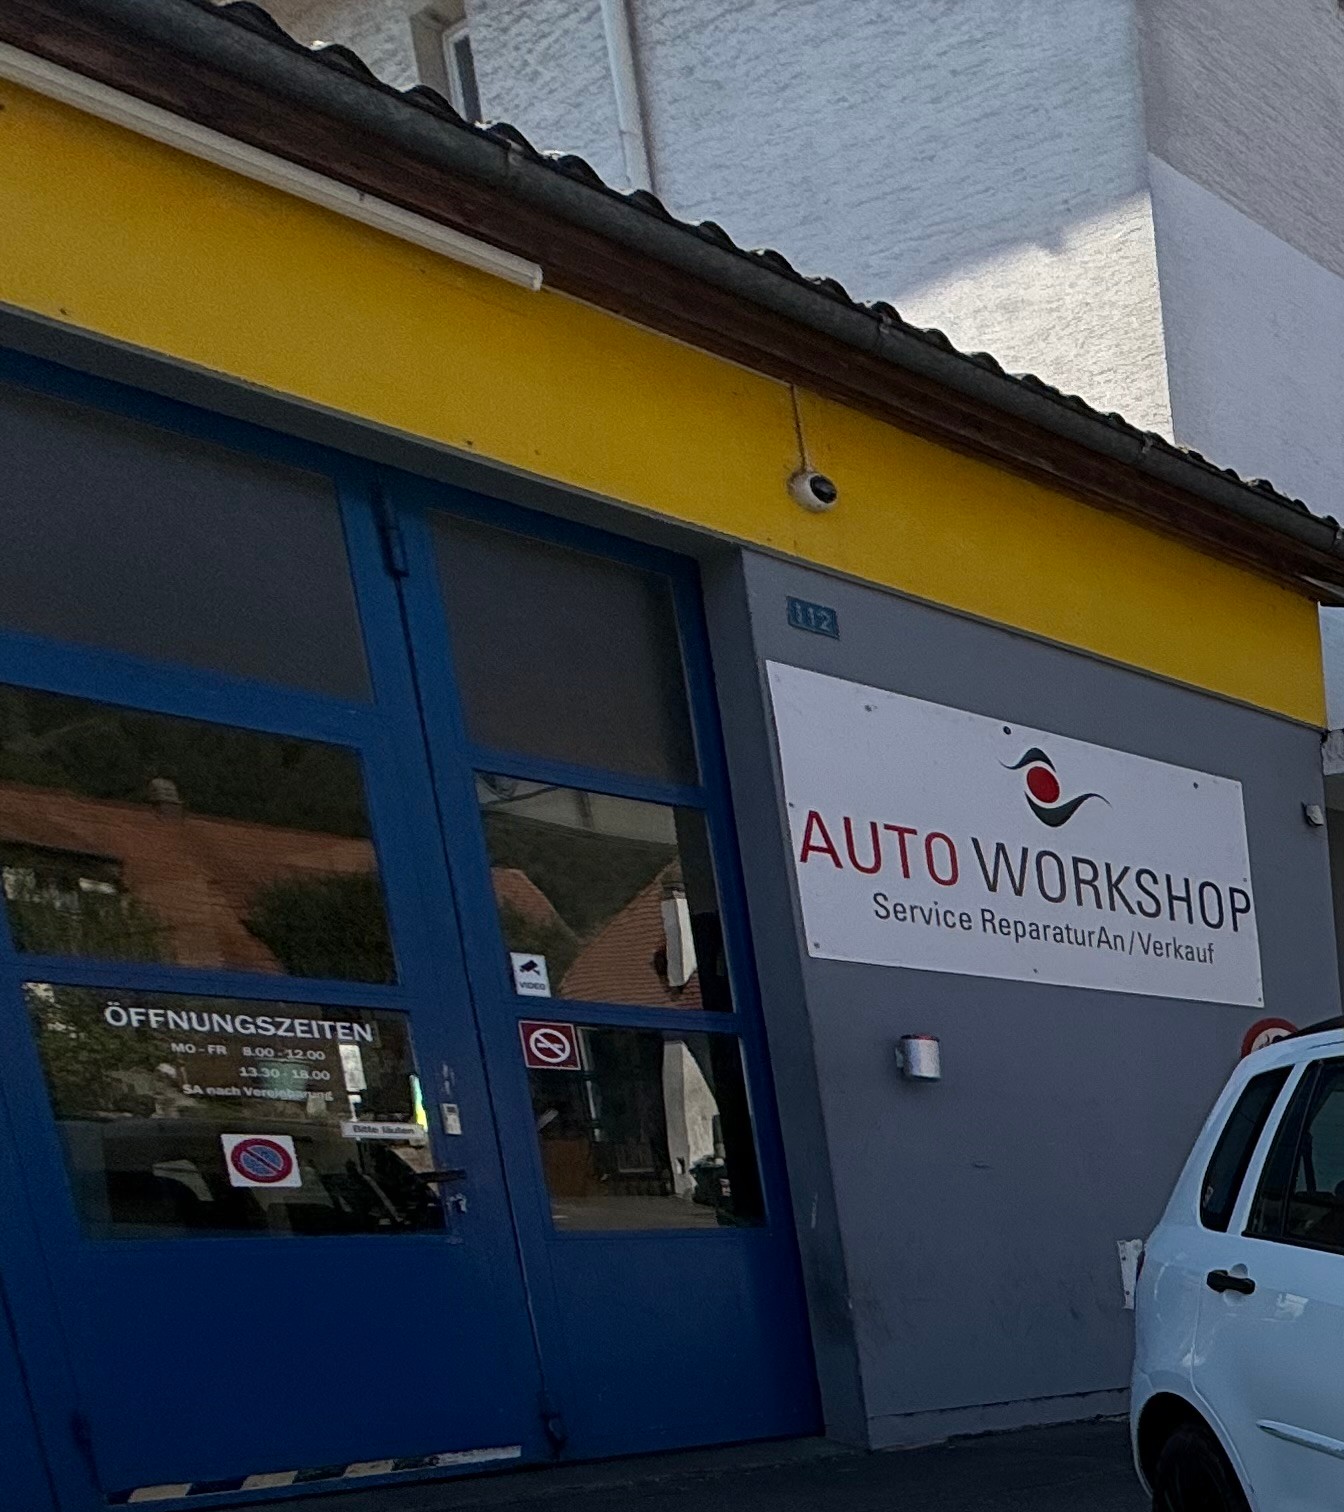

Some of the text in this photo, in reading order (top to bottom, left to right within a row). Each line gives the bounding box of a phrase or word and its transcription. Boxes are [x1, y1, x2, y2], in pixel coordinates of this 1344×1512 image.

[799, 809, 1252, 933] AUTO WORKSHOP
[872, 892, 973, 931] Service
[519, 981, 546, 991] VIDEO
[103, 1001, 374, 1043] ÖFFNUNGSZEITEN
[170, 1042, 197, 1055] MO
[207, 1044, 228, 1056] FR
[286, 1049, 326, 1061] 12.00
[239, 1066, 280, 1079] 13.30
[292, 1068, 331, 1081] 18.00
[183, 1083, 204, 1096] SA
[206, 1085, 241, 1097] nach
